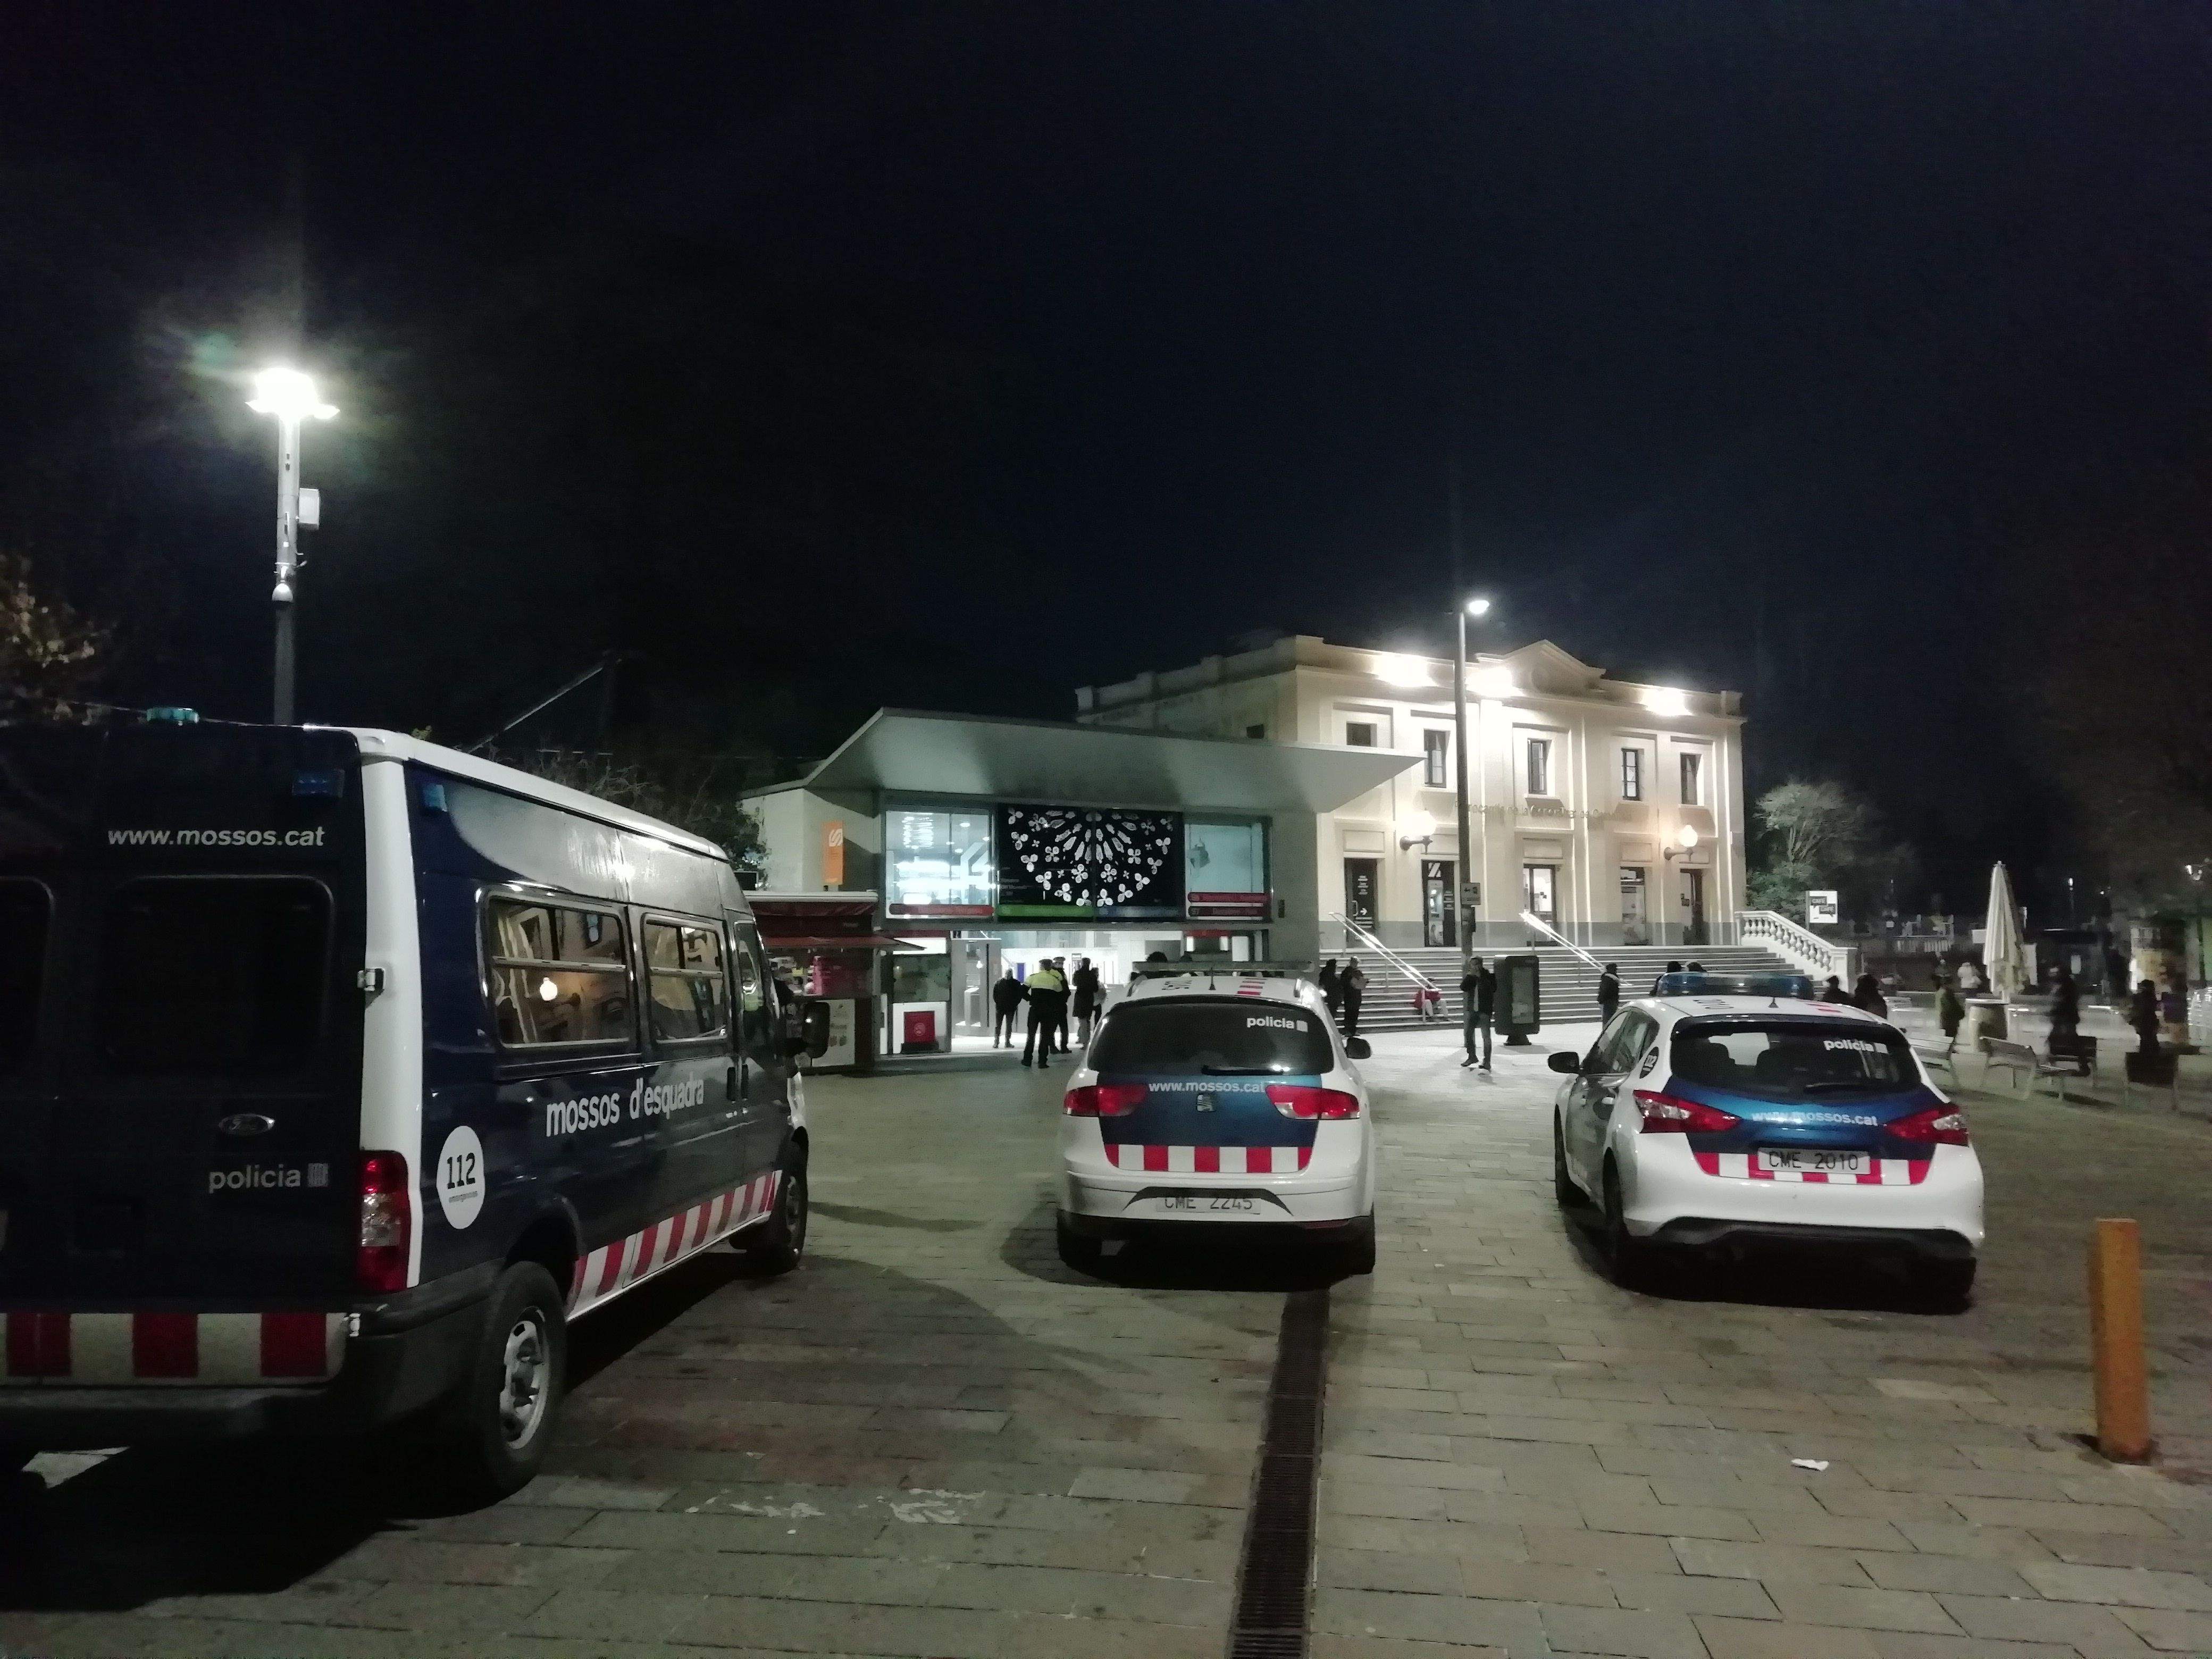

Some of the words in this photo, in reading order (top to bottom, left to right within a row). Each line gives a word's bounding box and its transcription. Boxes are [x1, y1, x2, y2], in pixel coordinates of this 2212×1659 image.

[107, 826, 325, 847] www.mossos.cat
[1148, 1081, 1267, 1093] www.mossos.cat
[546, 1093, 620, 1137] mossos
[630, 1071, 704, 1120] d'esquadra
[447, 1152, 476, 1189] 112
[1769, 1151, 1802, 1168] CME
[1814, 1152, 1858, 1170] 2010
[208, 1163, 301, 1194] policia
[1164, 1197, 1196, 1209] CME
[1210, 1198, 1253, 1210] 2245
